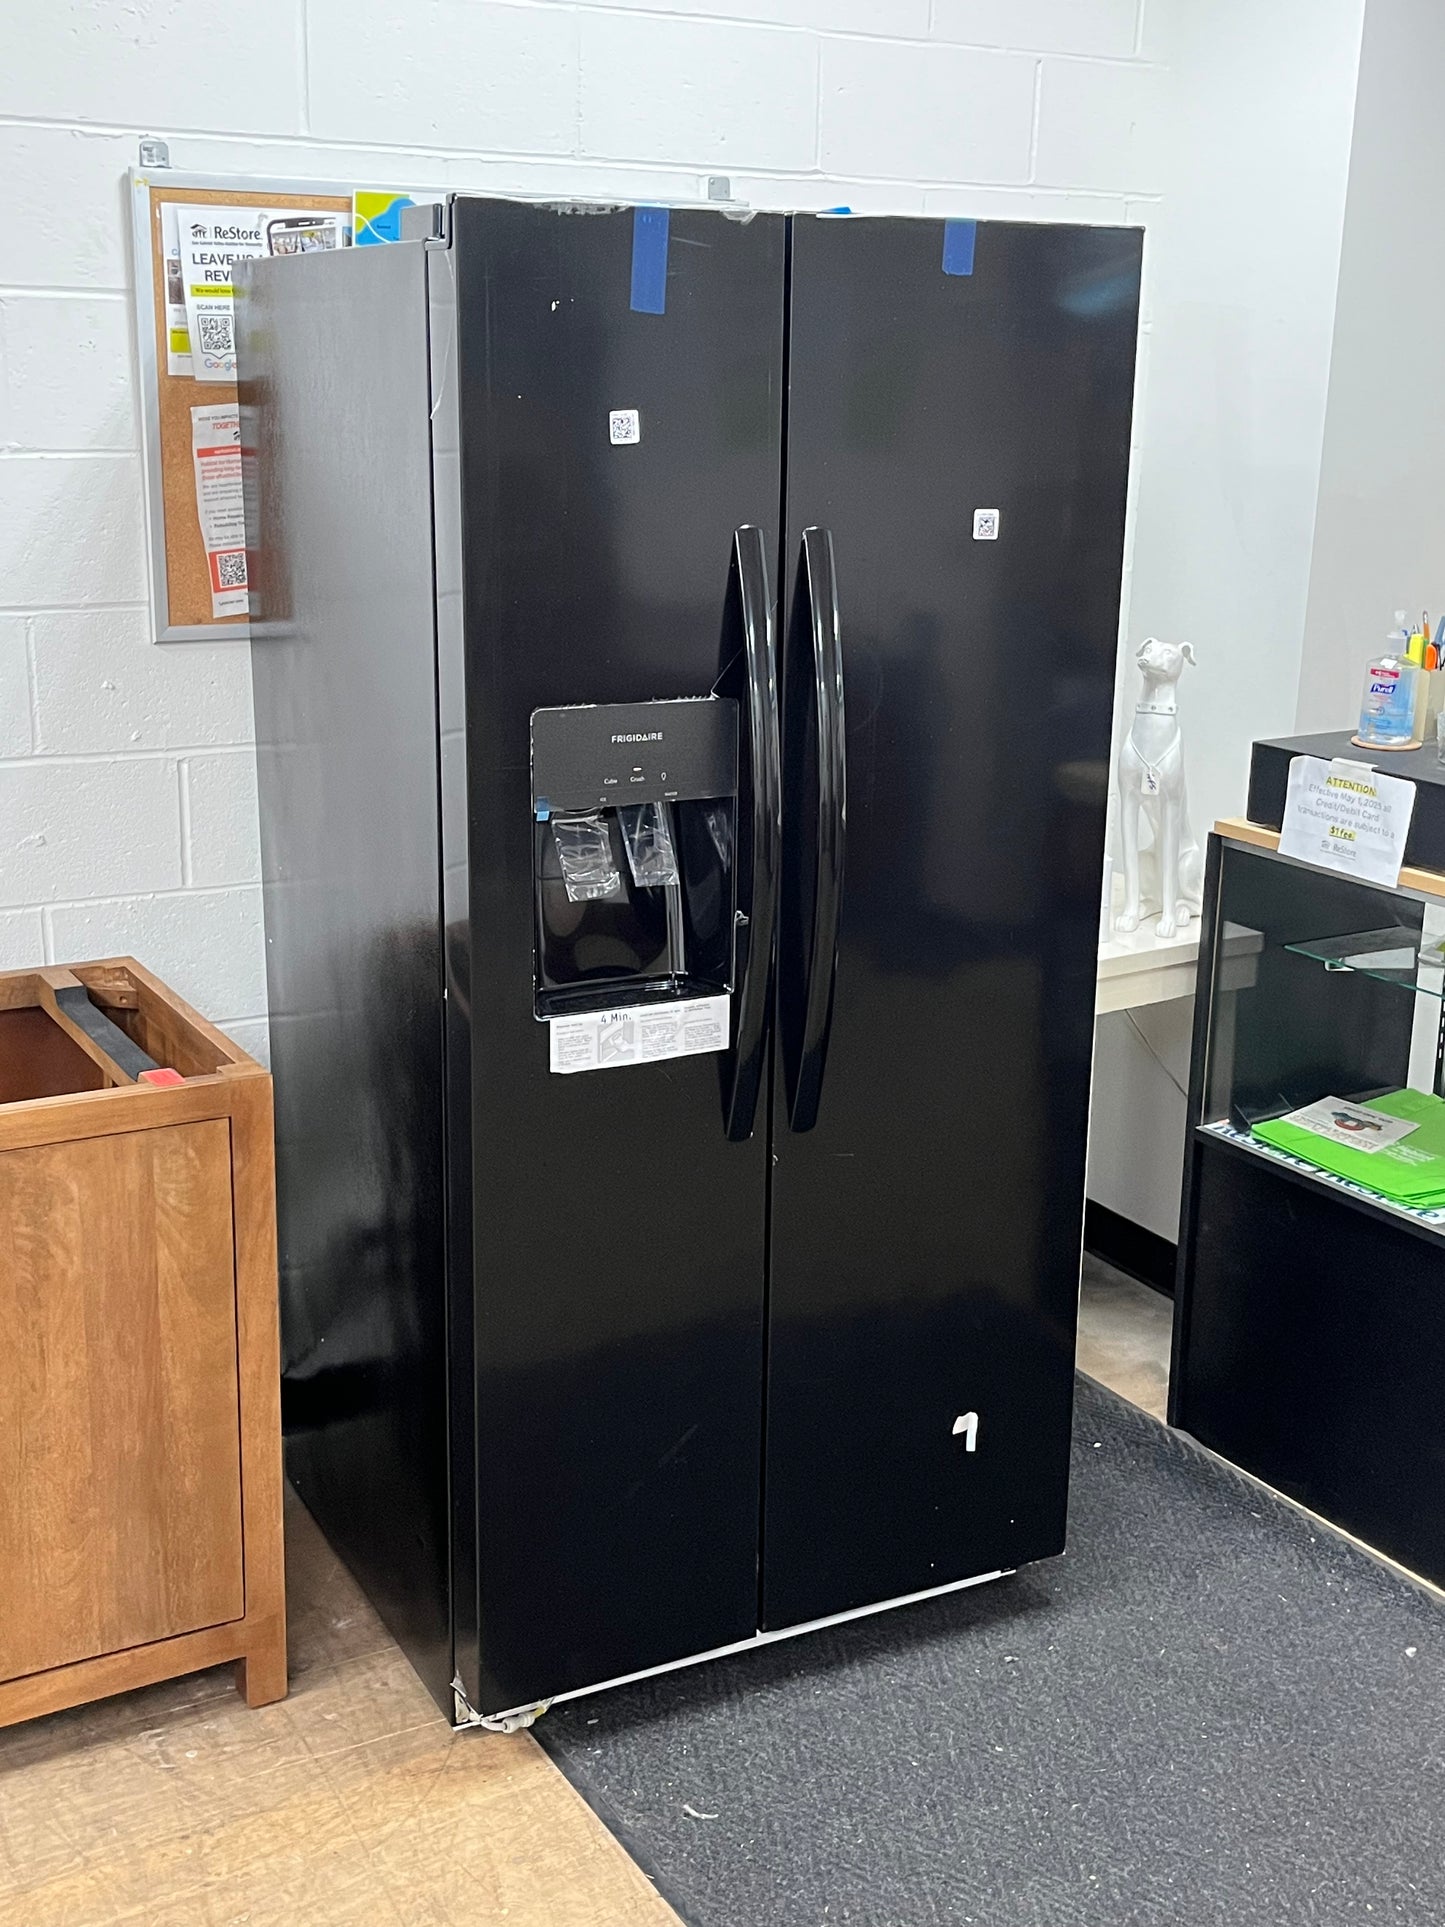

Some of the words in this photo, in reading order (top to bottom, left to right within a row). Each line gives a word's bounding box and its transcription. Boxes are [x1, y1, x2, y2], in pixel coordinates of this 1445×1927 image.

[213, 225, 262, 240] ReStore
[192, 253, 233, 266] LEAVE
[204, 270, 232, 282] REV
[212, 421, 240, 430] TOGETH
[1373, 684, 1395, 694] Purell
[611, 732, 663, 743] FRIGIDAIRE
[1308, 783, 1338, 799] Effective
[1340, 793, 1355, 805] May
[1315, 798, 1360, 817] Credit/Debit
[1362, 809, 1381, 822] Card
[1297, 805, 1339, 824] transactions
[1339, 818, 1354, 828] are
[1353, 822, 1380, 837] subject
[1381, 828, 1390, 837] to
[600, 1015, 607, 1024] 4
[610, 1012, 632, 1023] Min.
